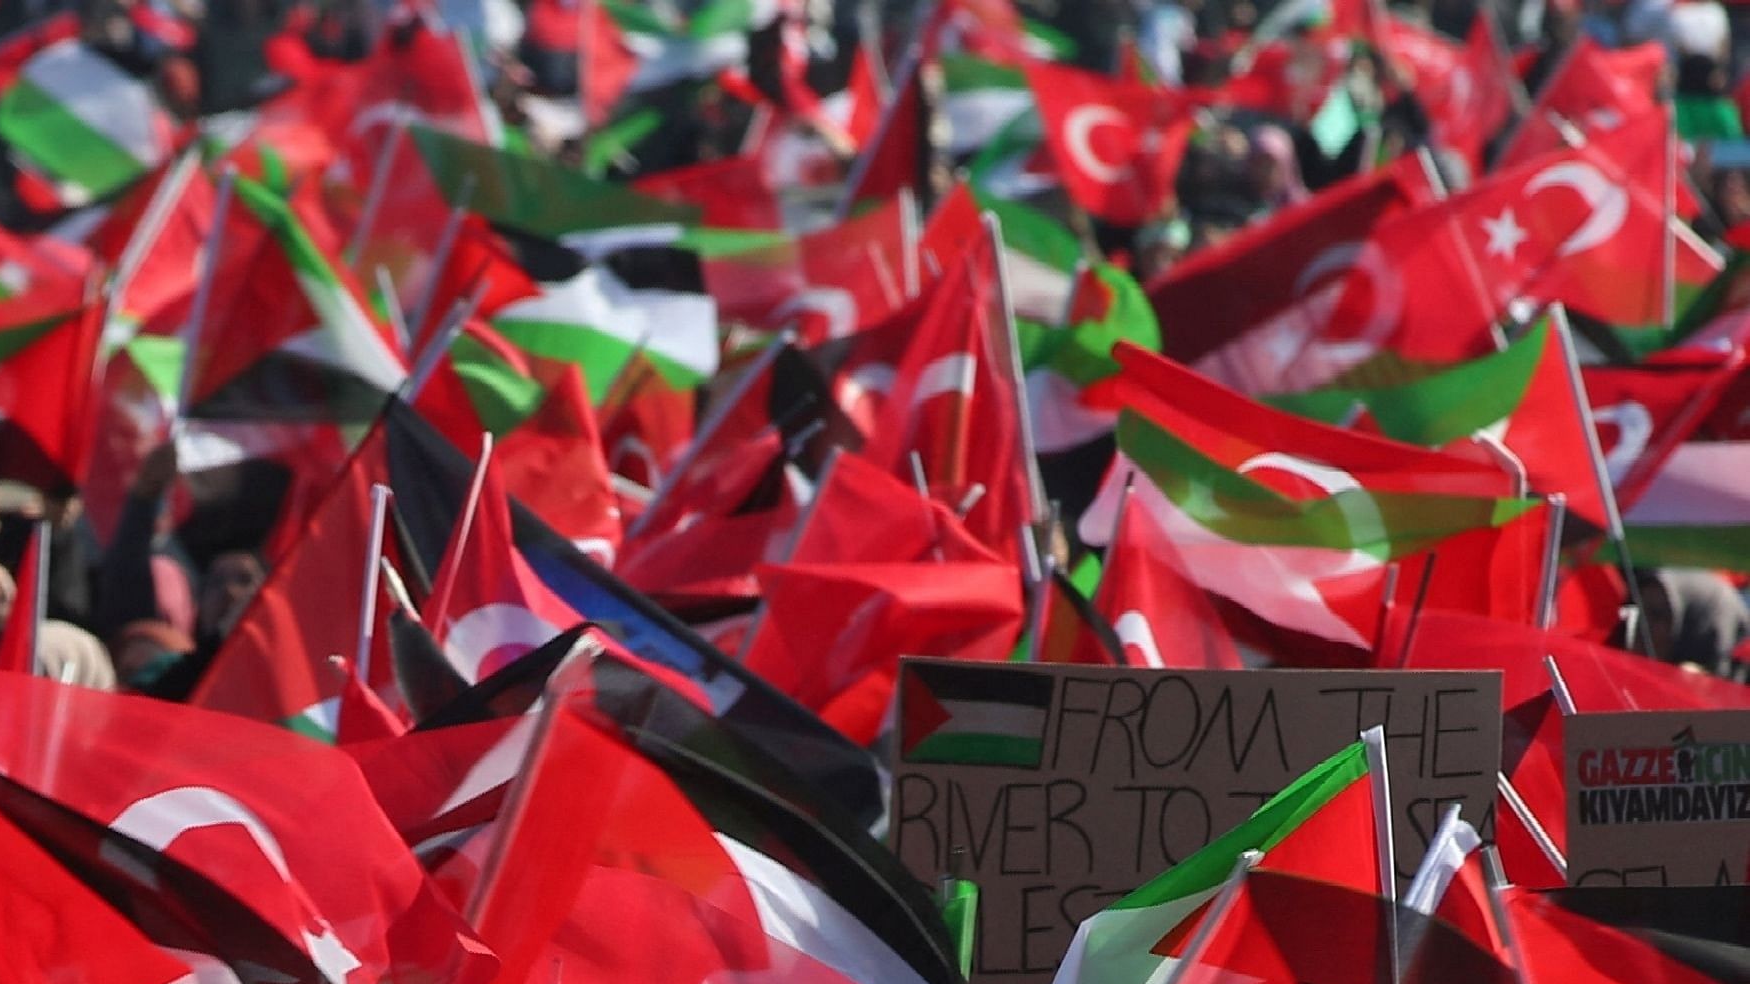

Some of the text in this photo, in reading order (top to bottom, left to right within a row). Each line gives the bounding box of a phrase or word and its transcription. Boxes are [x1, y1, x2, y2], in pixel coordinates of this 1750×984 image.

[1050, 675, 1484, 780] FROM THE
[1578, 746, 1675, 786] GAZZE
[894, 772, 1096, 878] RIVER
[1113, 786, 1212, 874] TO
[1579, 784, 1750, 824] KIYAMDAYIZ
